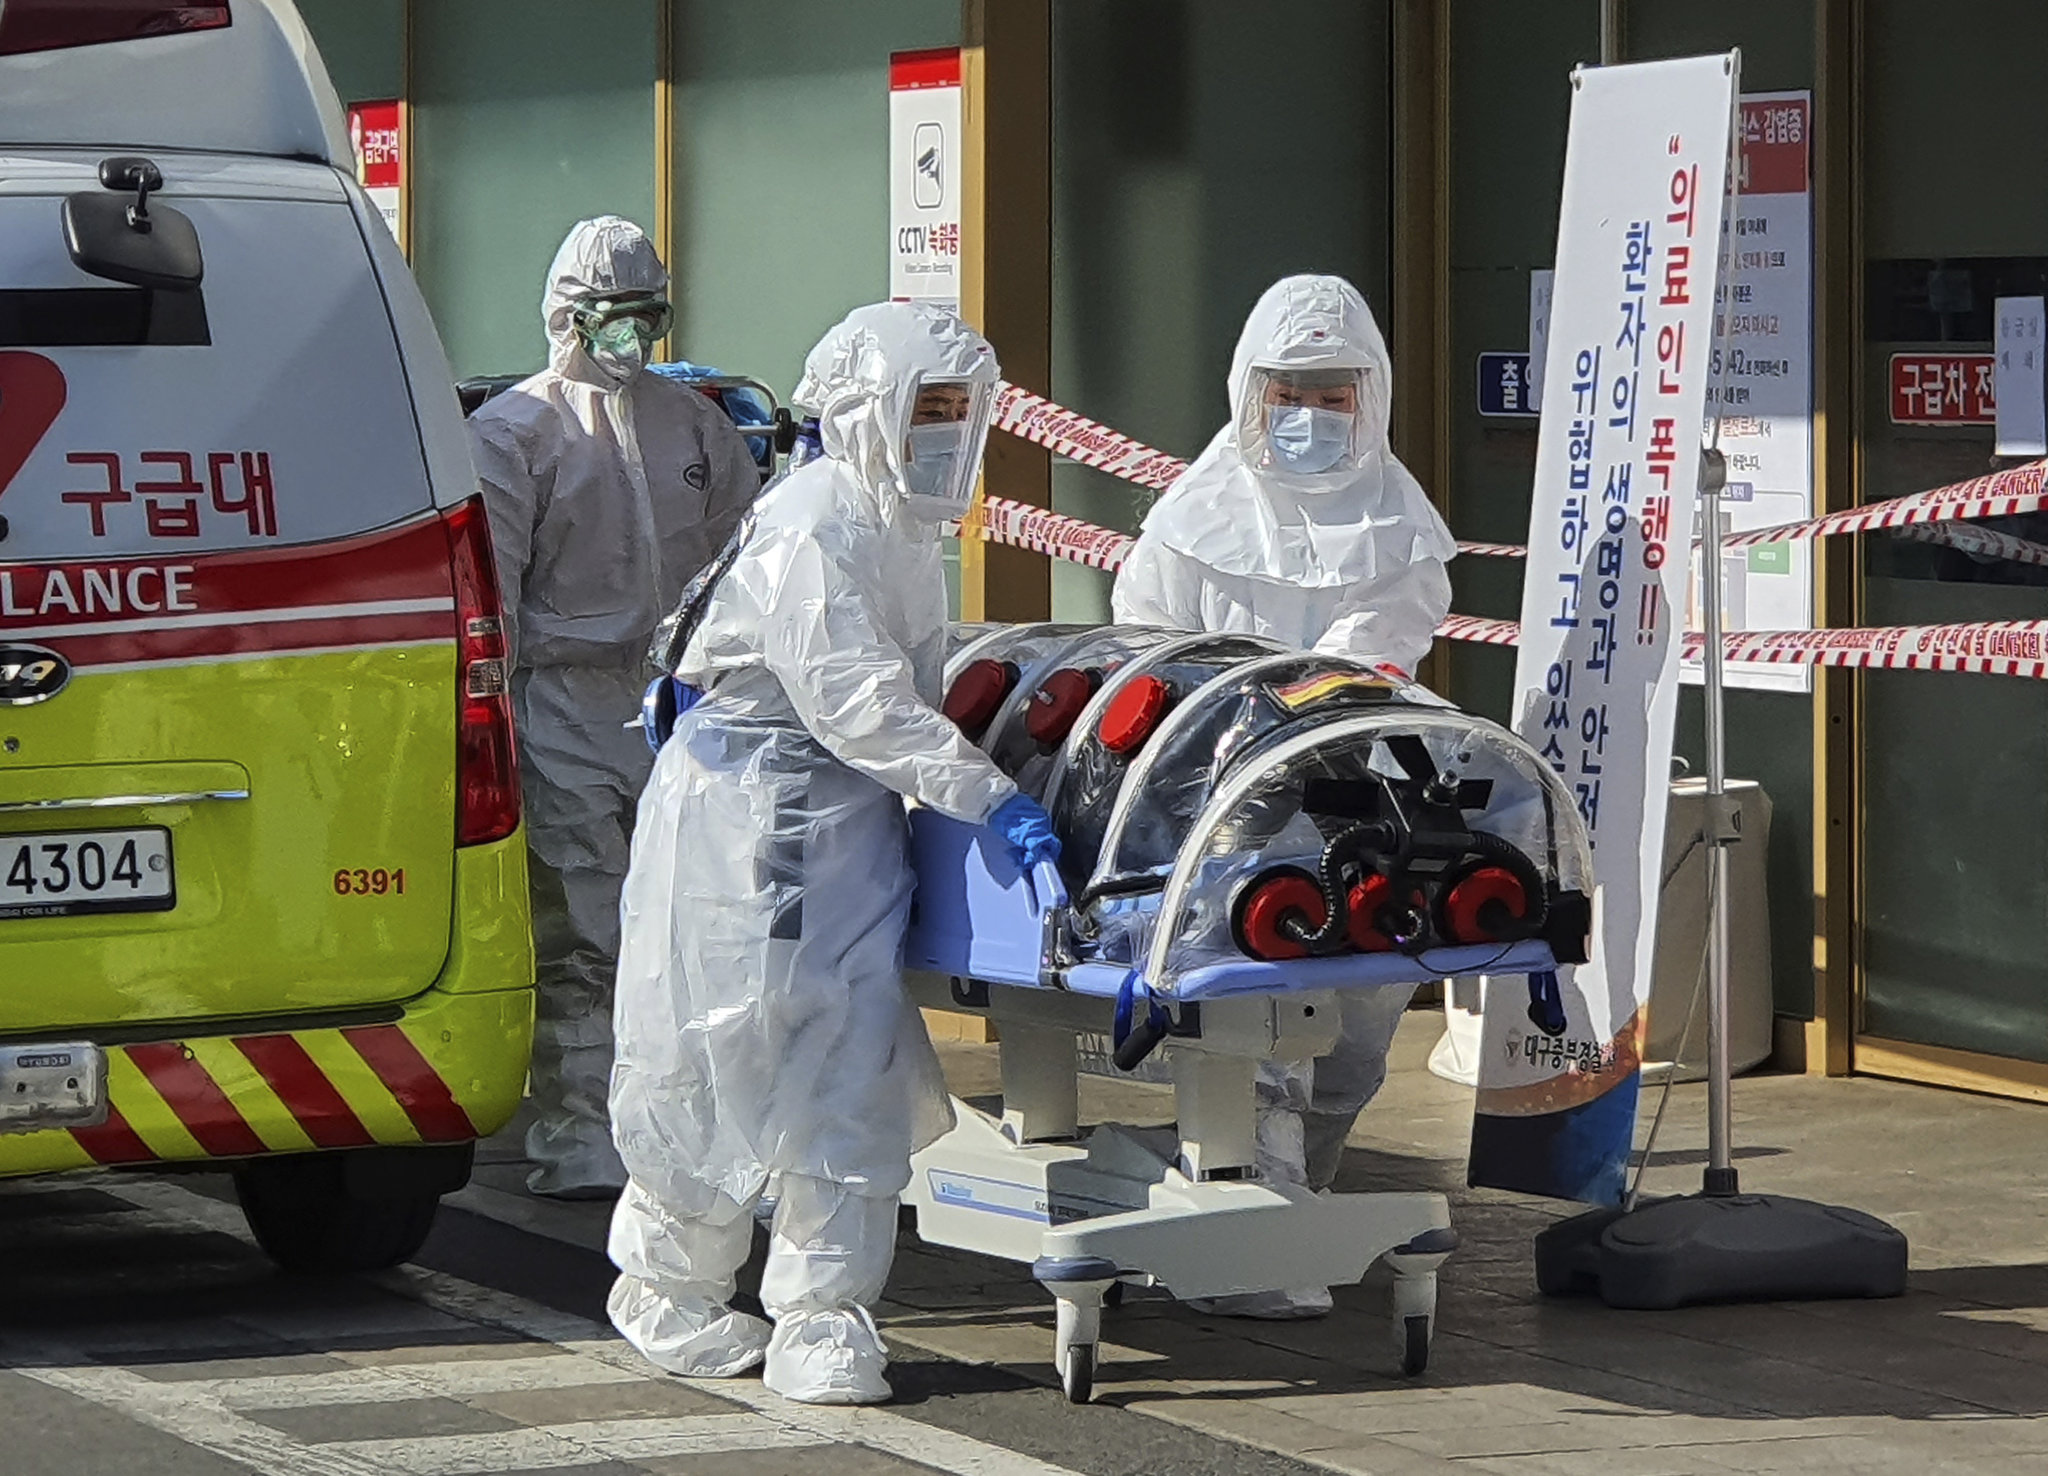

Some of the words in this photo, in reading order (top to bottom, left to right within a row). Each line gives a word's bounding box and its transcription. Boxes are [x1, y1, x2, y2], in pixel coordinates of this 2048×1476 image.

[1764, 108, 1801, 143] 감염증
[898, 226, 927, 254] CCTV
[928, 222, 958, 256] 녹화중
[1609, 220, 1652, 443] 환자의
[1900, 362, 1967, 416] 구급차
[60, 451, 279, 537] 구급대
[1550, 345, 1601, 629] 위험하고
[0, 566, 199, 617] LANCE
[1586, 461, 1633, 686] 생명과
[1990, 628, 2042, 659] DANGER
[5, 838, 144, 895] 4304
[332, 868, 406, 895] 6391
